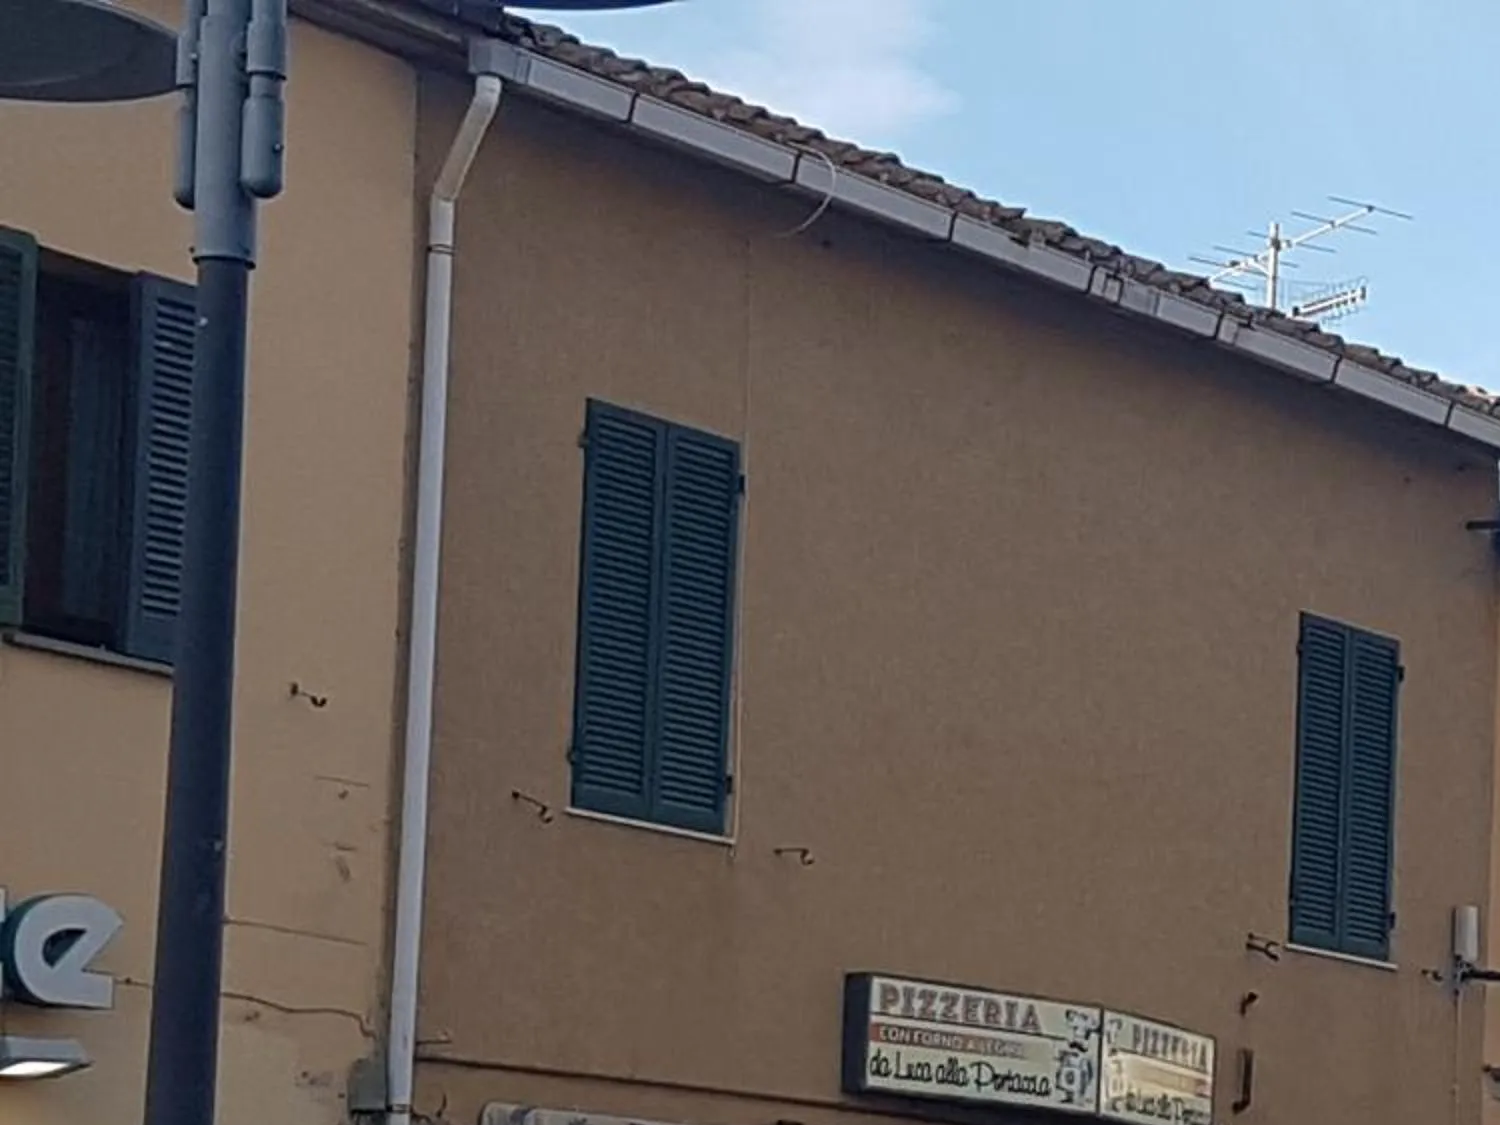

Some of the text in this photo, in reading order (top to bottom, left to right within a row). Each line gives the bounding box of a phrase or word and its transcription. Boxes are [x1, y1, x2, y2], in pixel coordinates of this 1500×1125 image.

[879, 983, 1041, 1033] PIZZERIA
[869, 1048, 892, 1077] da
[893, 1050, 933, 1082] Luca
[935, 1056, 969, 1086] alla
